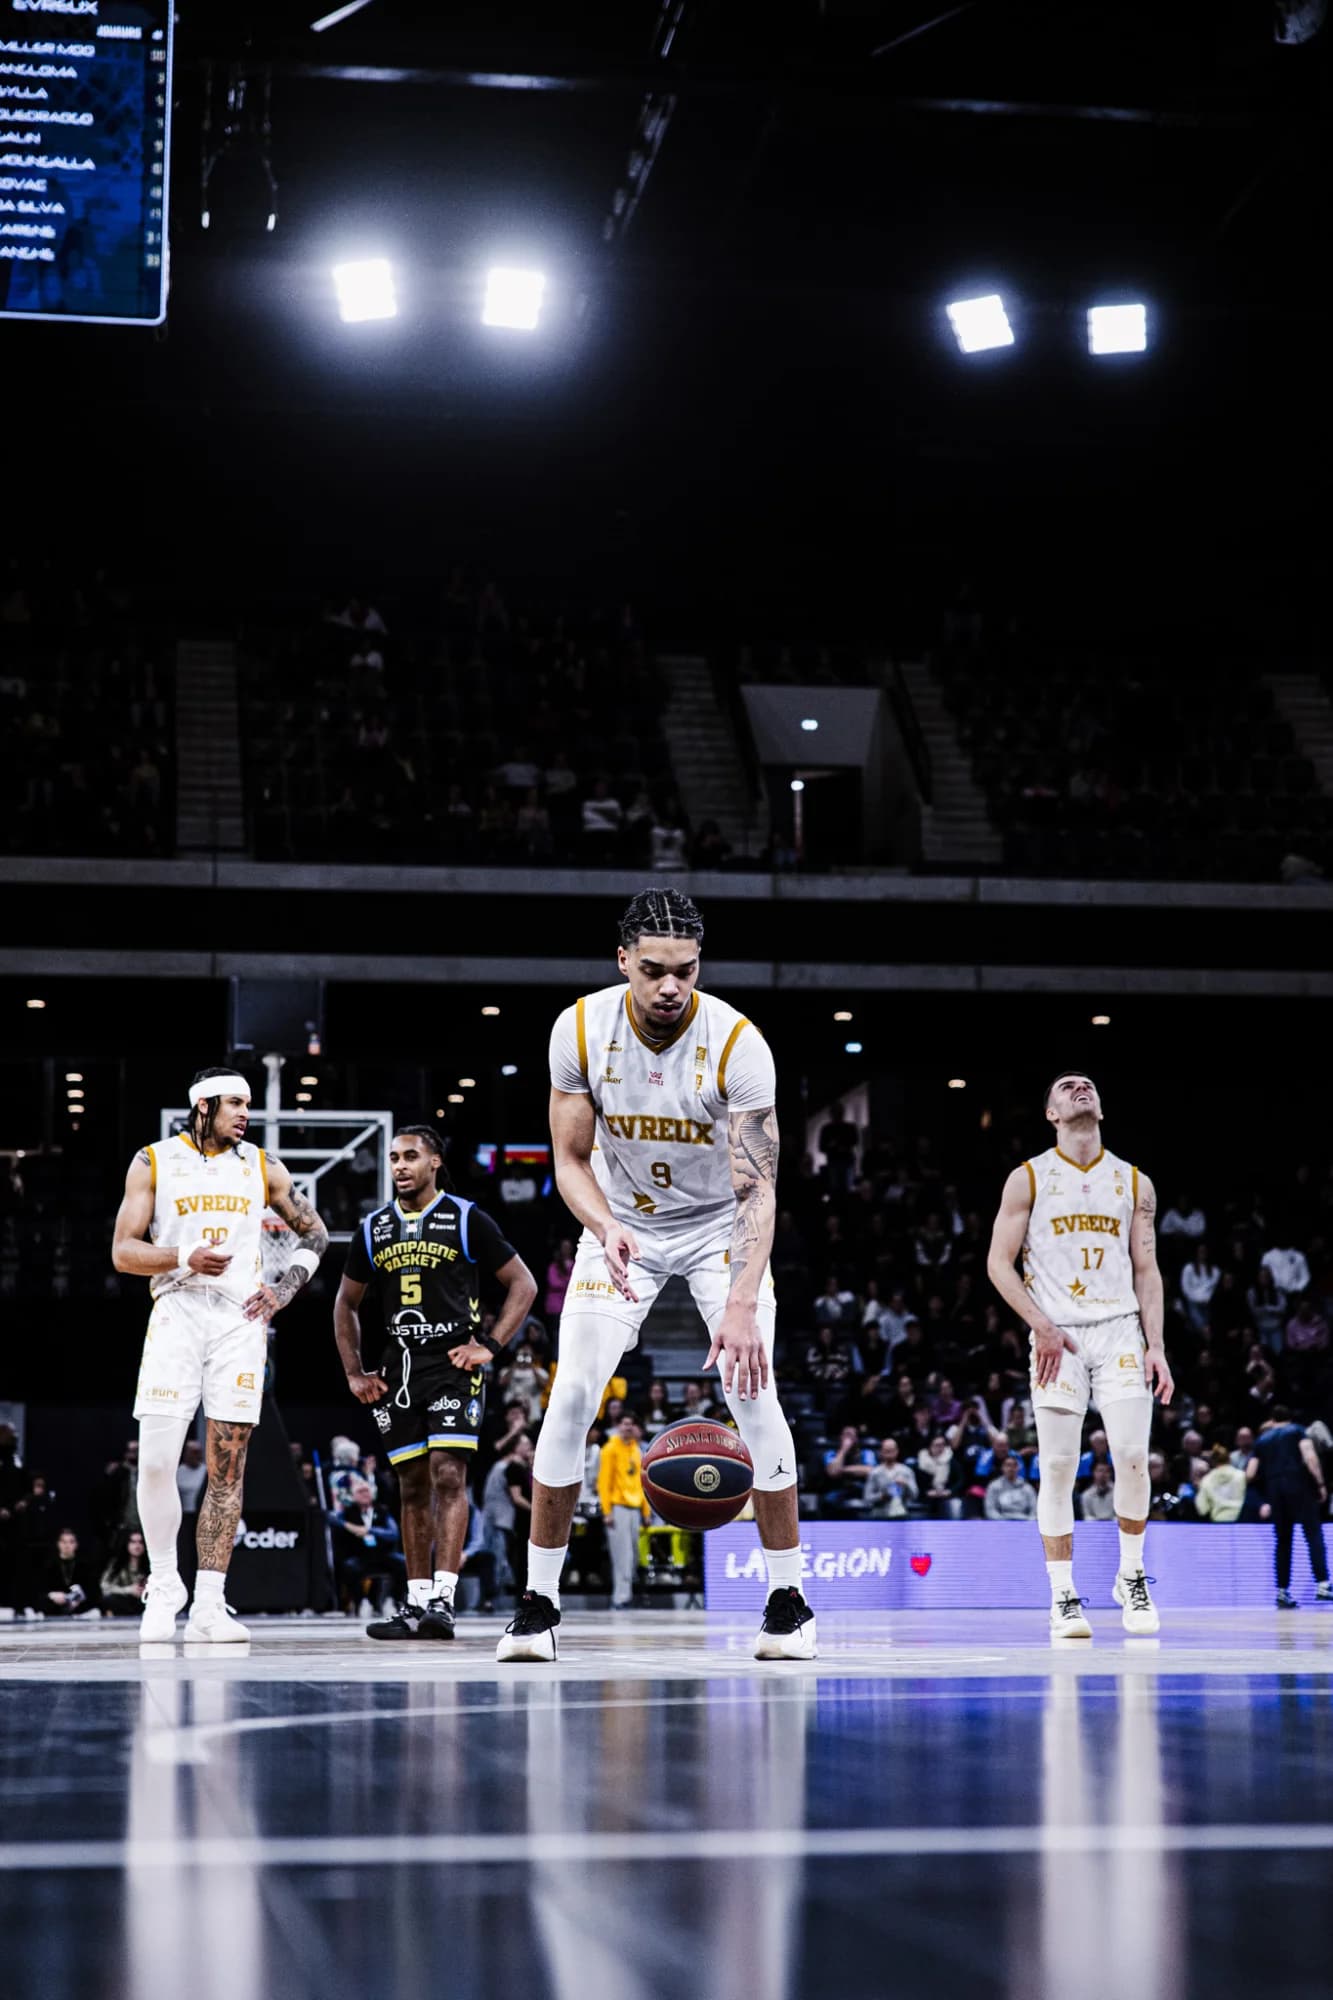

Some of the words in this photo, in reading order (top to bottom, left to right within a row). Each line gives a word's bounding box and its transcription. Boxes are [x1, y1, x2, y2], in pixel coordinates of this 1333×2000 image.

[604, 1115, 715, 1145] EVREUX
[650, 1161, 673, 1188] 9
[174, 1194, 252, 1216] EVREUX
[1051, 1213, 1121, 1237] EVREUX
[373, 1241, 458, 1267] CHAMPAGNE
[384, 1254, 441, 1272] BASKET
[1081, 1247, 1105, 1270] 17
[400, 1274, 422, 1305] 5
[800, 1543, 892, 1581] ÉGION
